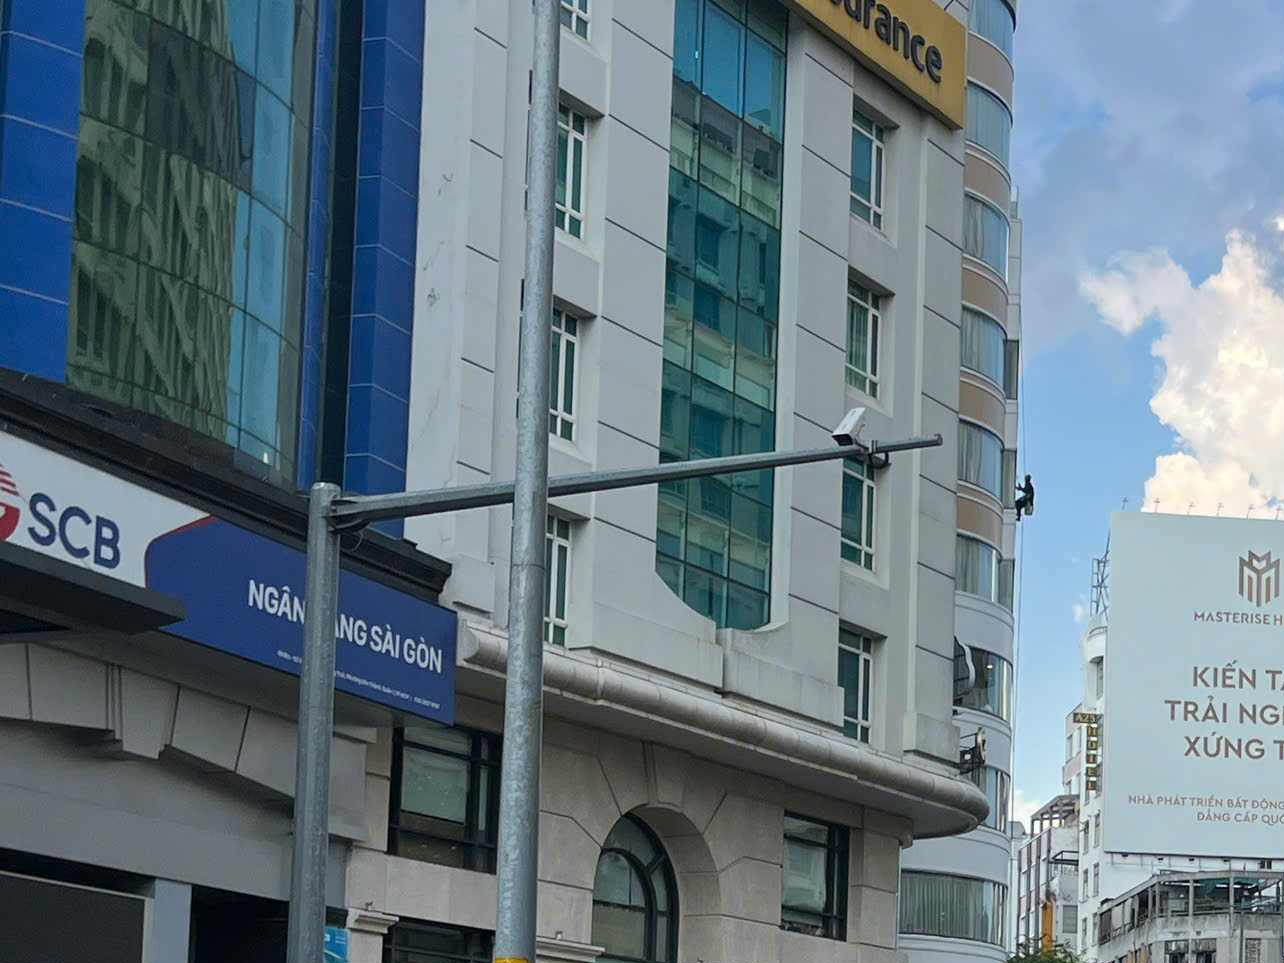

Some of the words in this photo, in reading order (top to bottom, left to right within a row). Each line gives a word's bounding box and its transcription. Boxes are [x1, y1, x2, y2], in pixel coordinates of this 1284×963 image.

[829, 0, 942, 83] urance
[28, 492, 121, 569] SCB
[248, 579, 305, 625] NGÂN
[369, 624, 401, 659] SÀI
[403, 636, 442, 674] GÒN
[1193, 611, 1270, 625] MASTERISE
[1192, 660, 1256, 689] KIẾN
[1164, 696, 1227, 723] TRẢI
[1184, 731, 1265, 760] XỨNG
